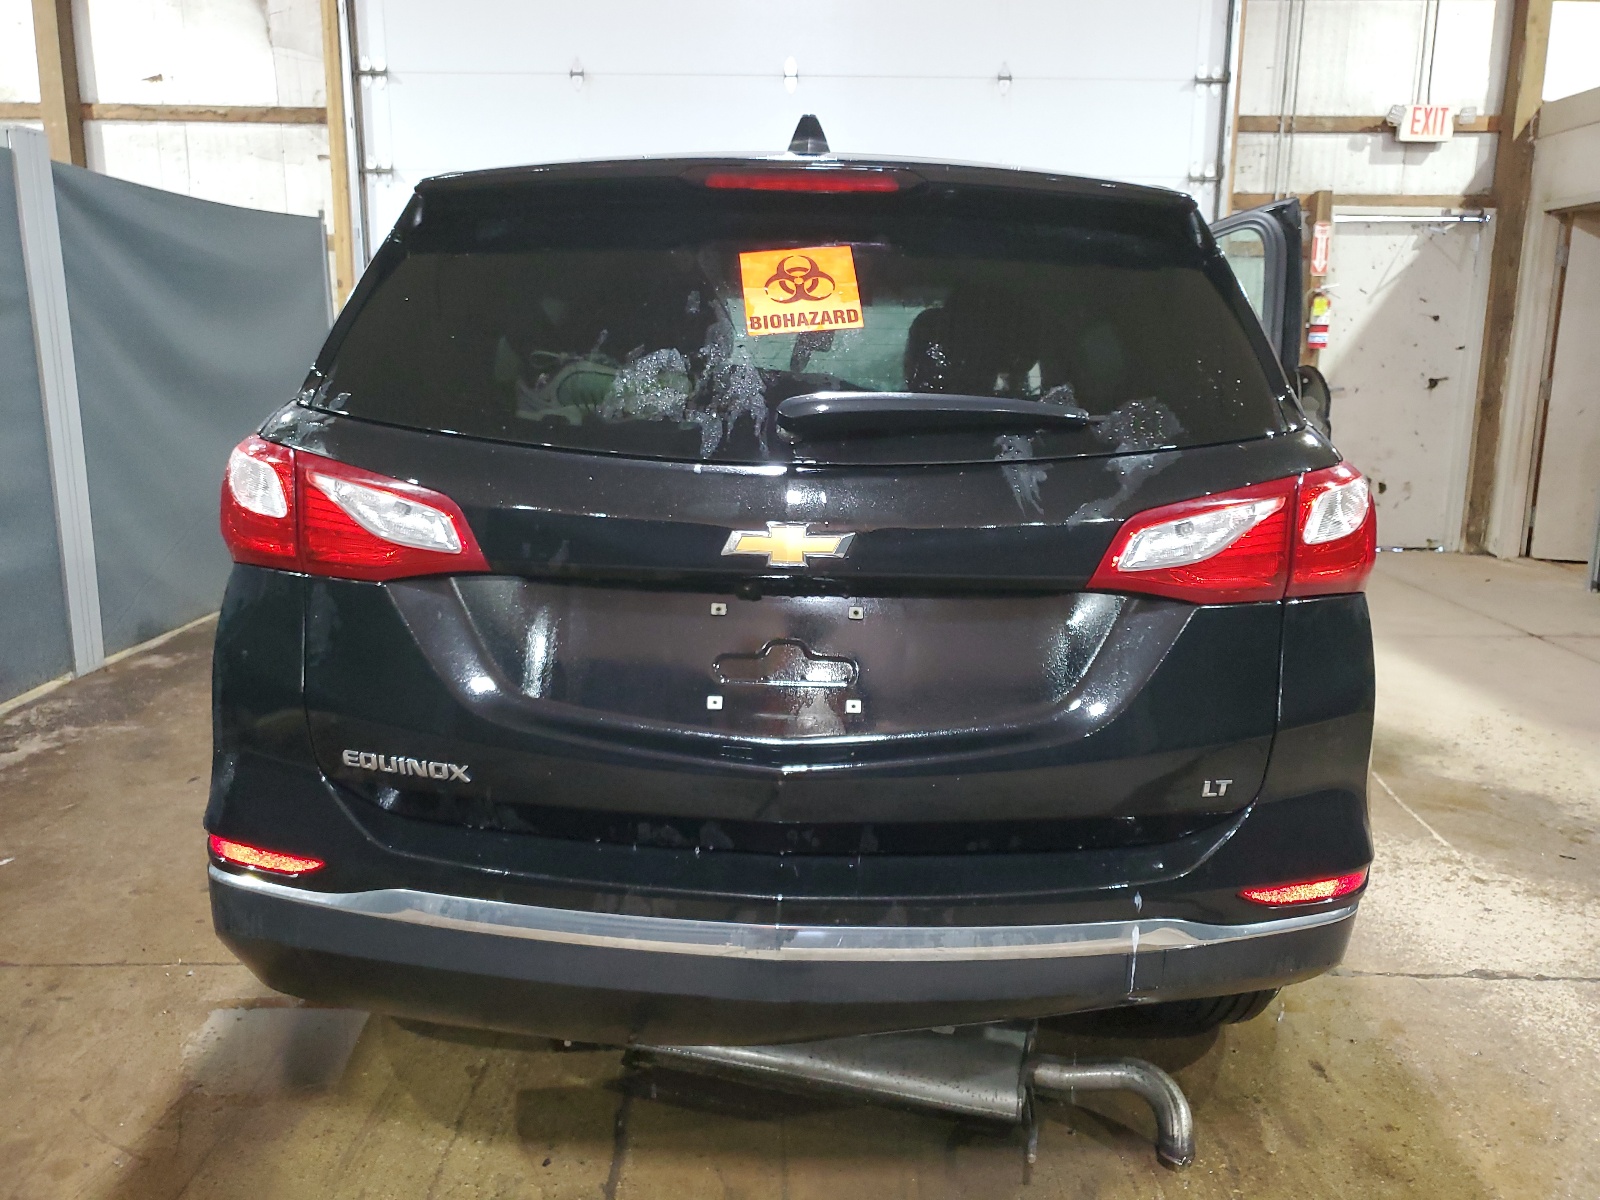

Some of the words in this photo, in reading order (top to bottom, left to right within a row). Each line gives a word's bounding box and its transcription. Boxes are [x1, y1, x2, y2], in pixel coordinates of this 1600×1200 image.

[1410, 106, 1449, 136] EXIT
[749, 308, 859, 330] BIOHAZARD
[342, 749, 471, 784] EQUINOX
[1201, 779, 1233, 798] LT
